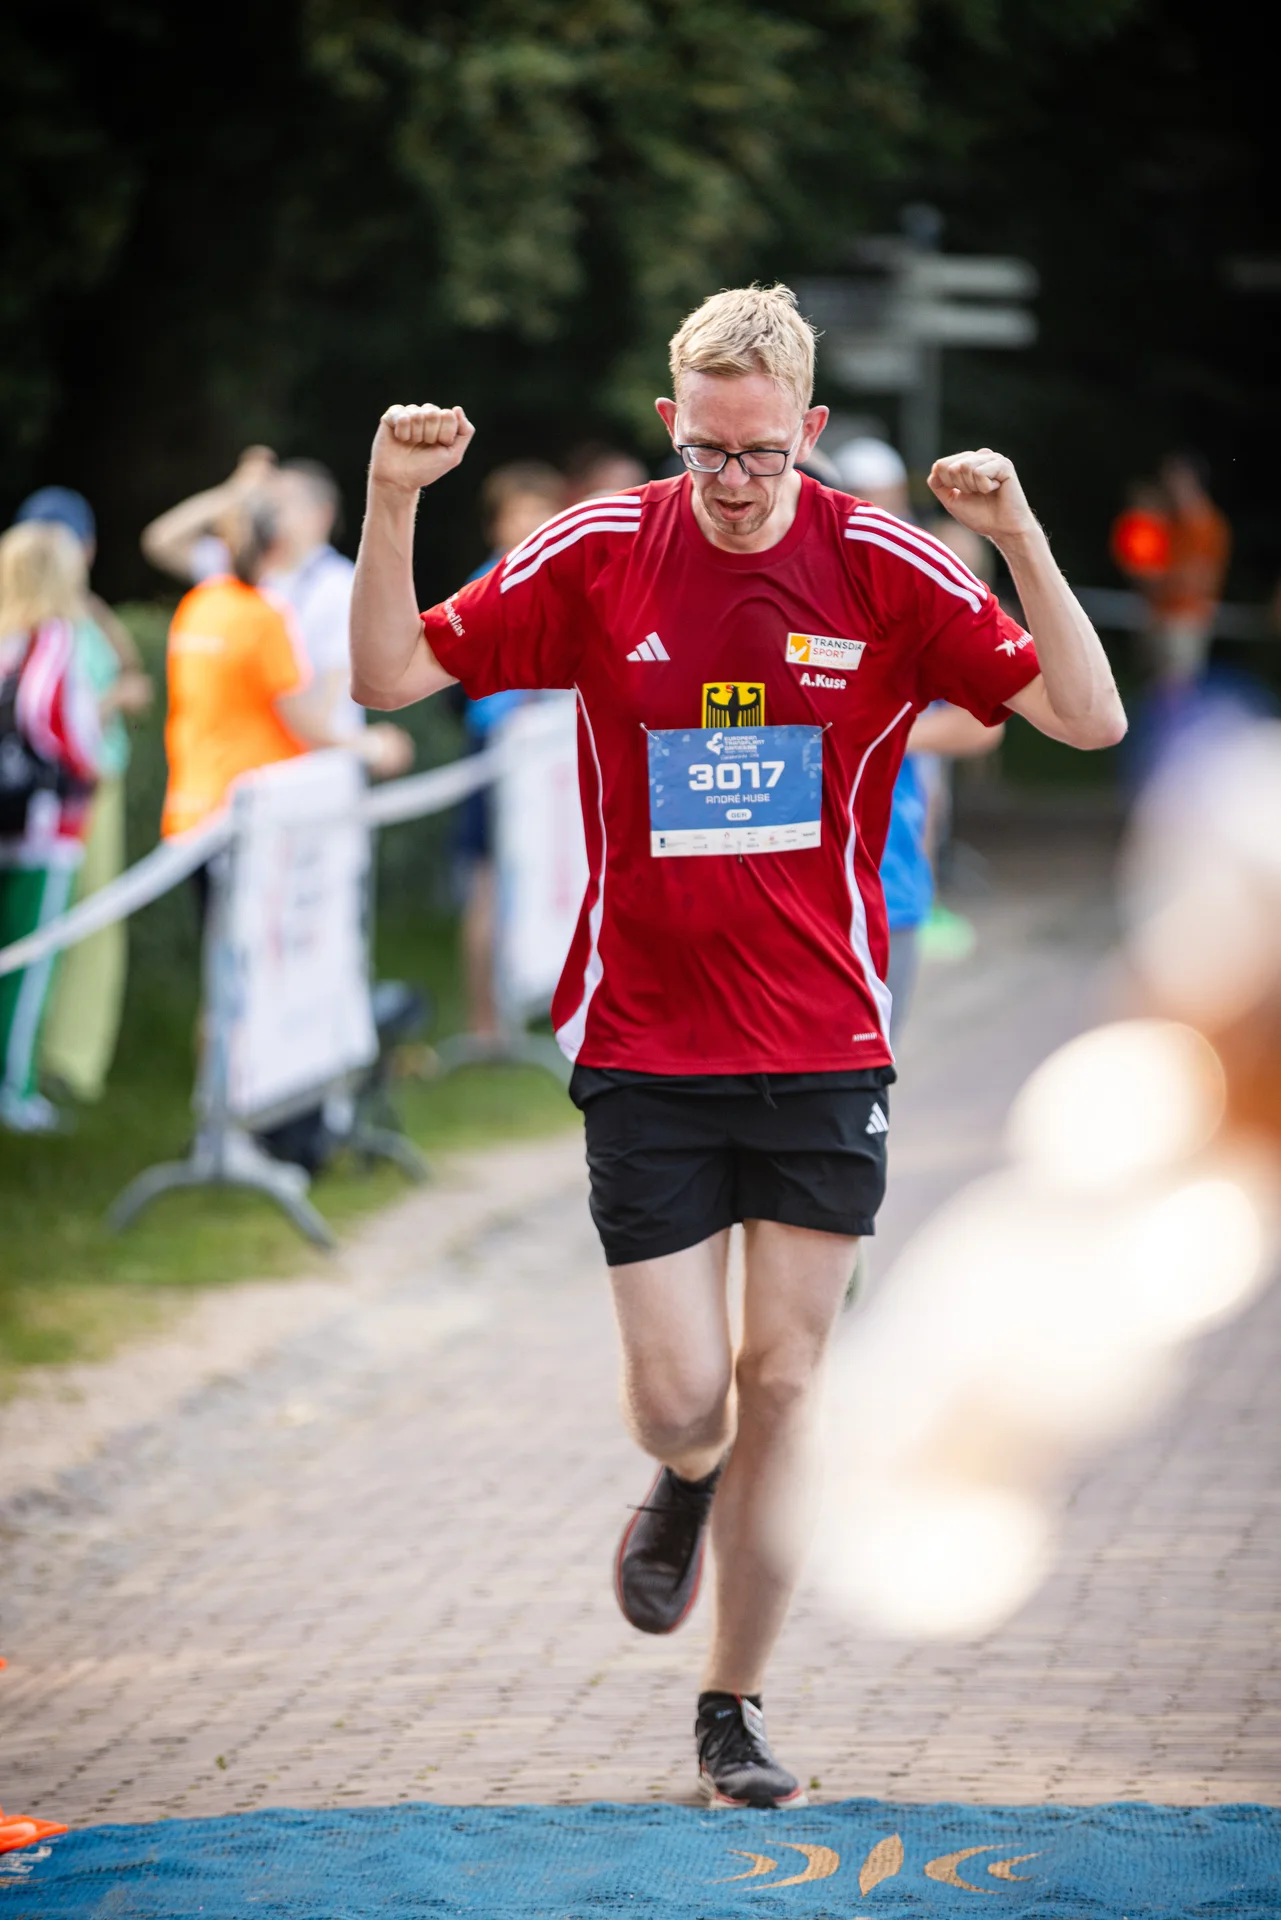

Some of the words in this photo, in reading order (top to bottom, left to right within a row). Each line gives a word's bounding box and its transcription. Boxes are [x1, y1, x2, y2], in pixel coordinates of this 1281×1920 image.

[813, 647, 845, 659] SPORT
[800, 672, 847, 690] A.Kuse
[688, 761, 785, 791] 3017
[705, 793, 741, 804] ANDRÉ
